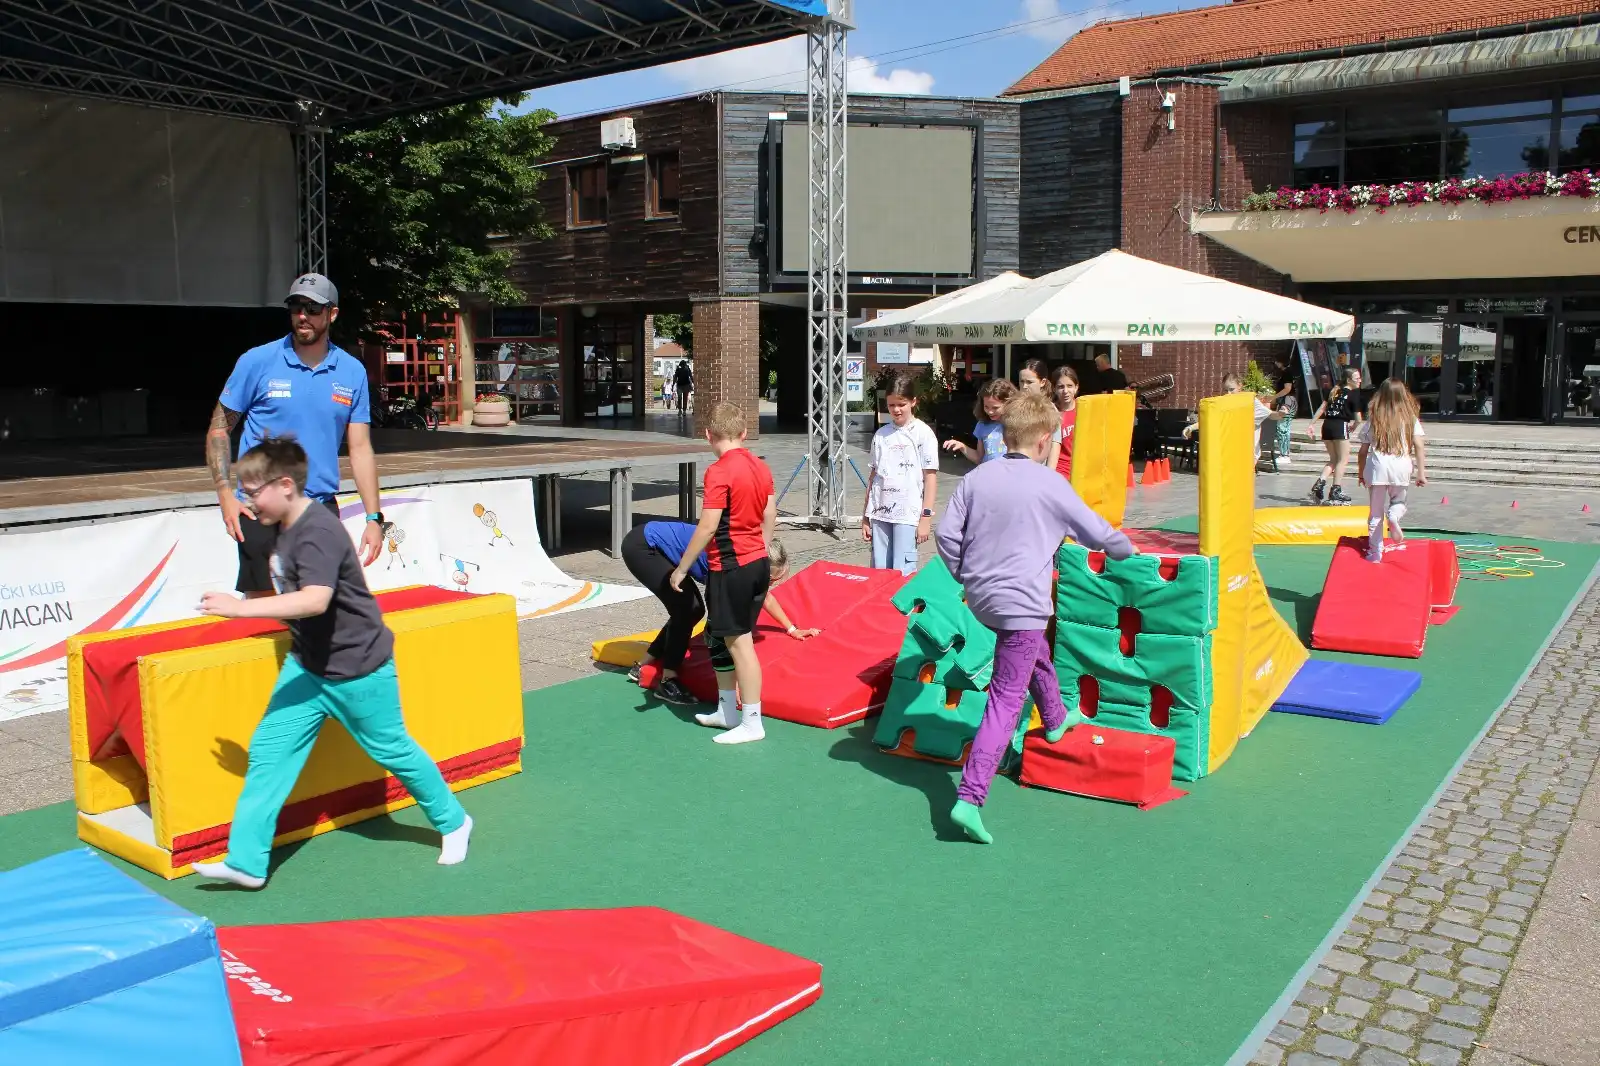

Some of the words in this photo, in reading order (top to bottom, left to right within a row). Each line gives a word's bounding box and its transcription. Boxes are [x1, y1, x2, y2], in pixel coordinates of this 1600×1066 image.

[963, 325, 979, 338] PAN
[1046, 323, 1085, 337] PAN
[1126, 323, 1166, 337] PAN
[1213, 322, 1251, 336] PAN
[1287, 322, 1323, 335] PAN
[28, 580, 66, 597] KLUB
